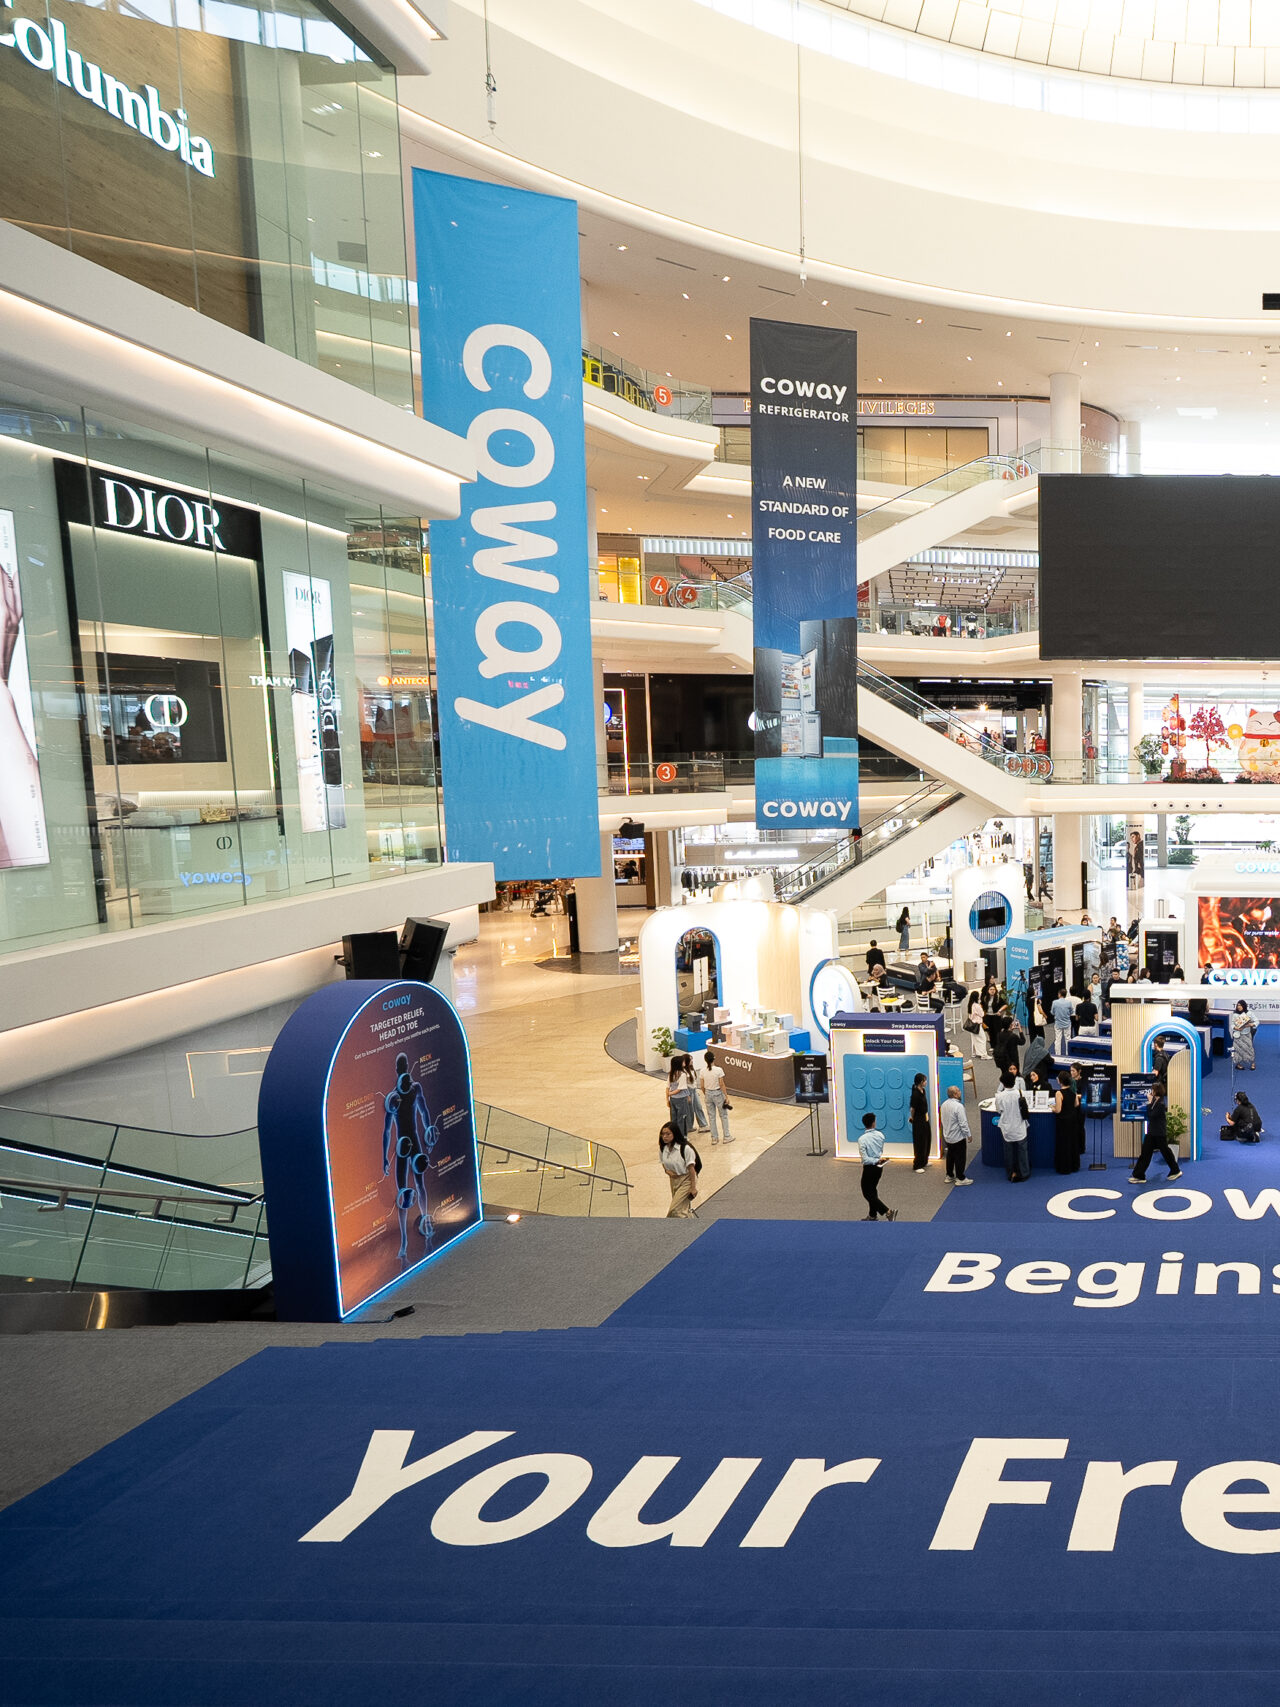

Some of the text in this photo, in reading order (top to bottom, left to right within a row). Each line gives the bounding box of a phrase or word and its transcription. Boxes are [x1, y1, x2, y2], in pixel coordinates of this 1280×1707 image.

[0, 0, 214, 178] olumbia
[658, 387, 668, 404] 5
[760, 376, 848, 405] coway
[759, 403, 849, 423] REFRIGERATOR
[857, 400, 935, 416] IVILEGES
[783, 475, 826, 489] A NEW
[99, 477, 227, 550] DIOR
[759, 500, 849, 518] STANDARD OF
[455, 323, 567, 751] coway
[768, 527, 841, 544] FOOD CARE
[654, 578, 663, 593] 4
[295, 587, 321, 605] DIOR
[321, 667, 335, 732] DIOR
[661, 766, 671, 780] 3
[763, 799, 852, 821] coway
[1012, 946, 1028, 955] coway
[382, 993, 412, 1011] coway
[370, 1007, 425, 1033] TARGETED RELIEF,
[892, 1023, 905, 1031] Swag
[379, 1020, 419, 1041] HEAD TO TOE
[366, 1047, 377, 1056] know
[376, 1044, 386, 1054] your
[385, 1040, 395, 1050] body
[419, 1053, 432, 1063] NECK
[724, 1056, 753, 1072] coway
[298, 1430, 882, 1548] Your
